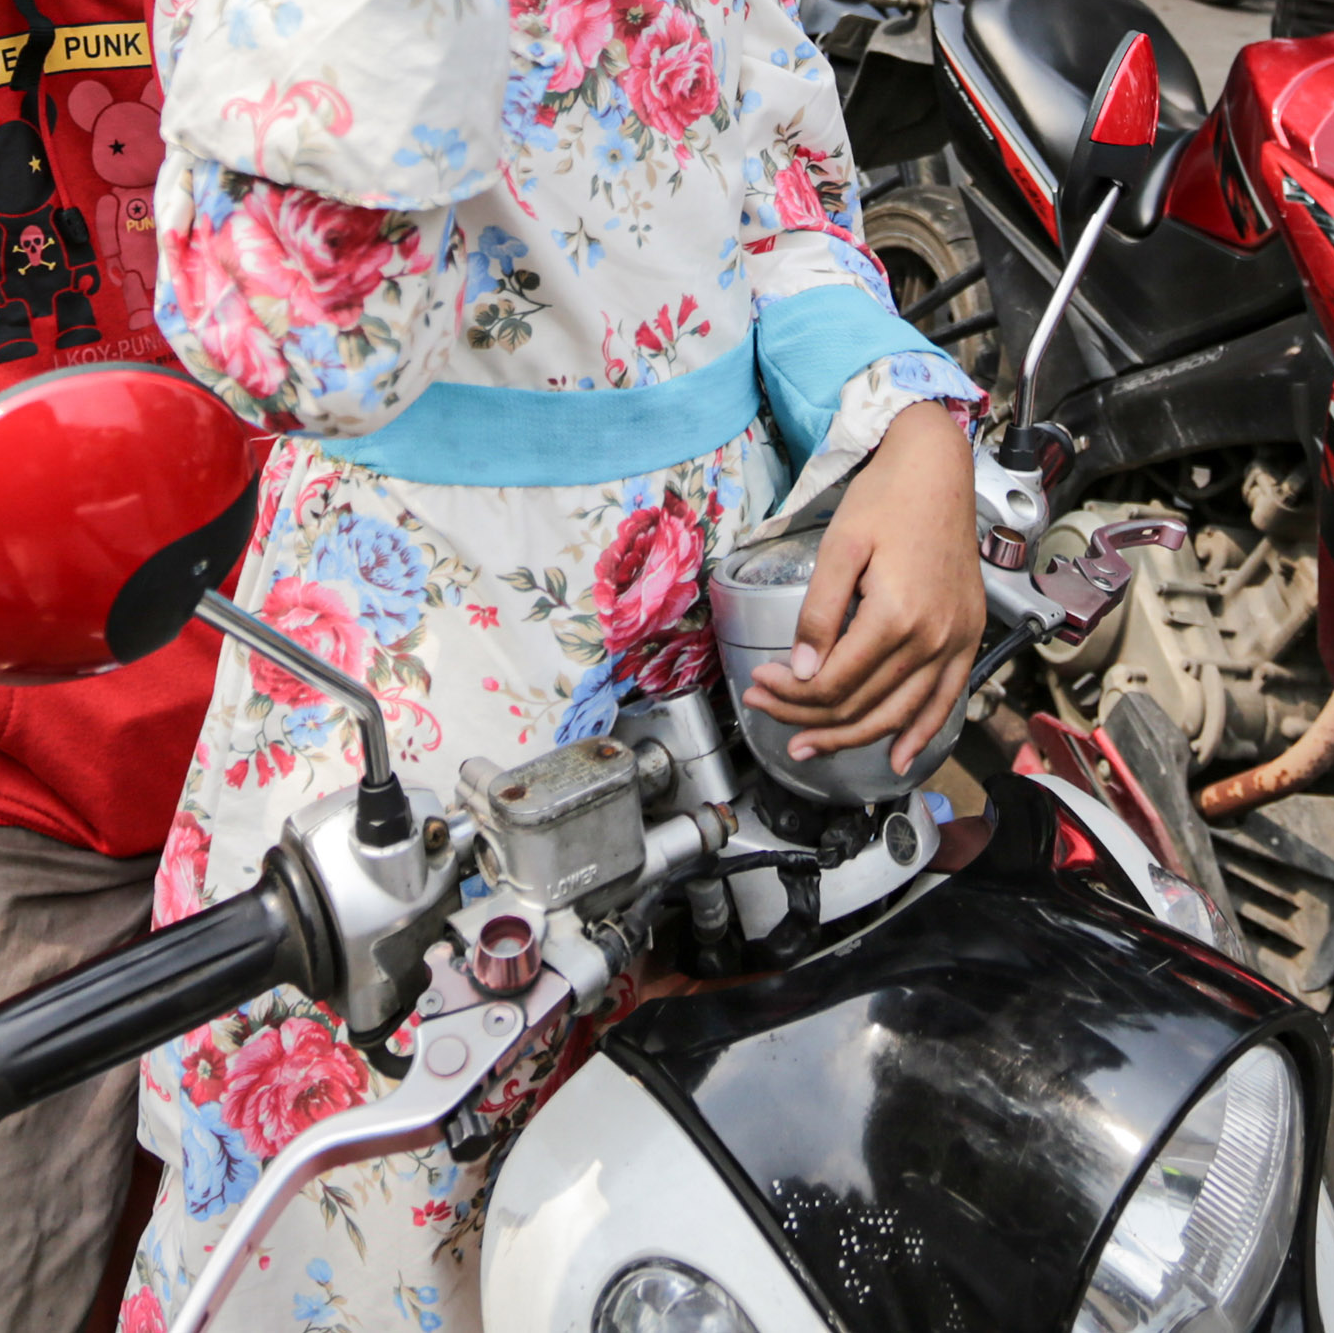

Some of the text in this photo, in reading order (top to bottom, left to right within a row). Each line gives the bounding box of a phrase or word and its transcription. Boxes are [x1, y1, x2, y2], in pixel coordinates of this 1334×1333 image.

[64, 32, 143, 60] PUNK
[125, 217, 155, 233] PUN
[546, 864, 598, 901] LOWER
